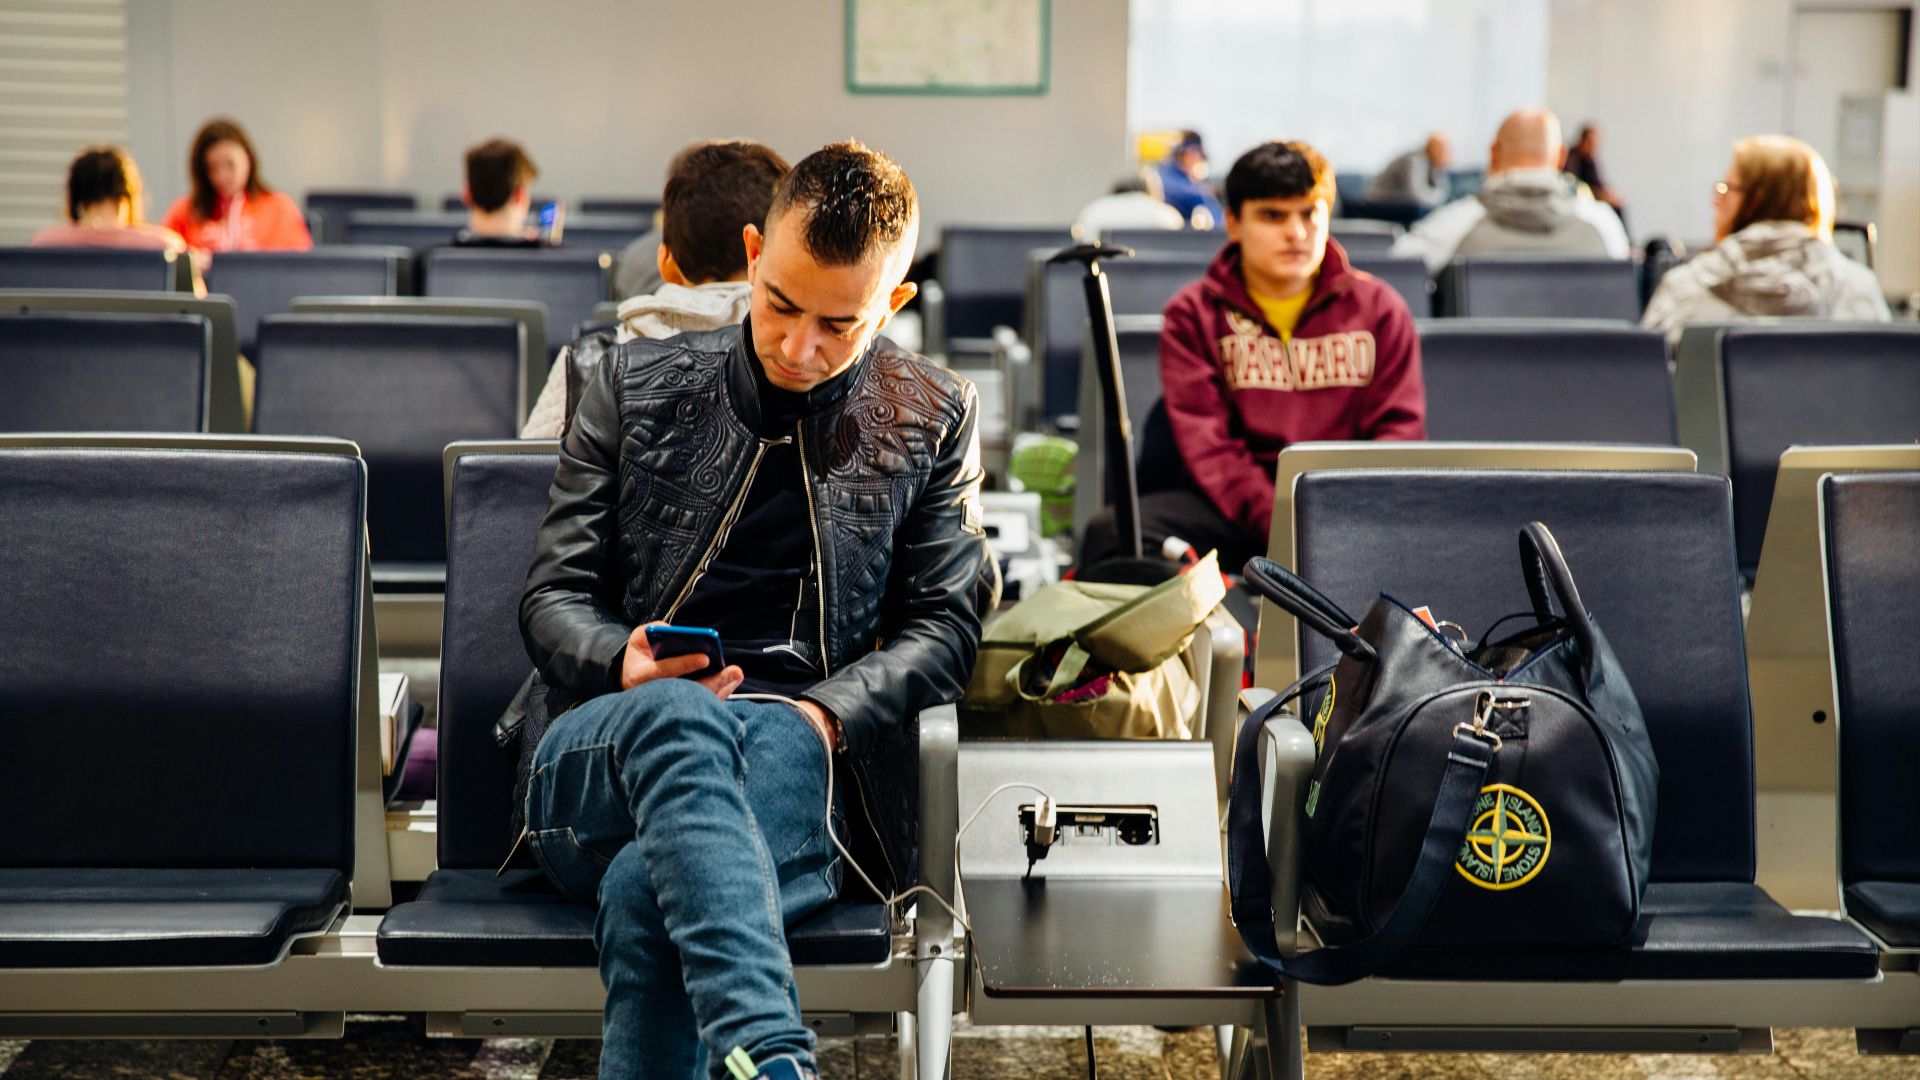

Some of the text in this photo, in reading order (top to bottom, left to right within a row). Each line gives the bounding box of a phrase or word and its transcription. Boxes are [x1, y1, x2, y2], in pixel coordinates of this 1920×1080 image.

[1221, 331, 1376, 391] HARVARD
[1504, 794, 1542, 835] ISLAND
[1502, 845, 1541, 882] STONE
